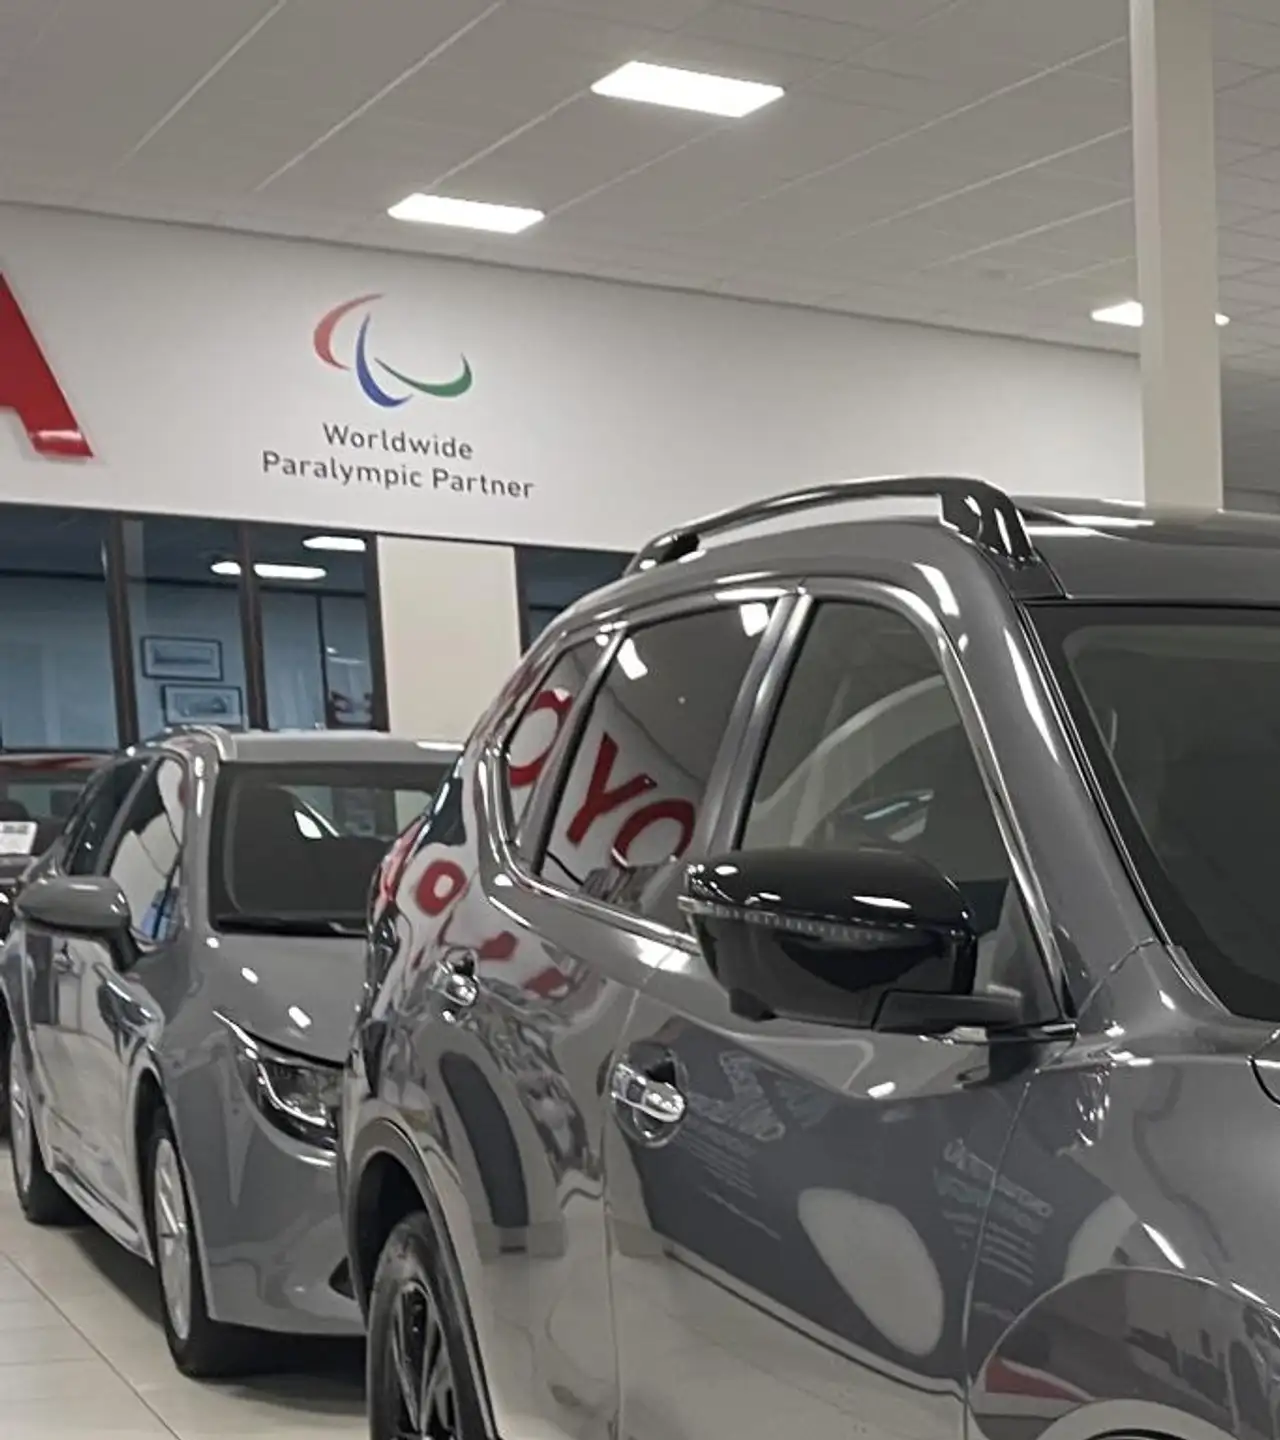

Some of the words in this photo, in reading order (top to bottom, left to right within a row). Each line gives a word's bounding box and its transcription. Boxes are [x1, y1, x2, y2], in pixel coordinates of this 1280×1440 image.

[323, 422, 473, 460] Worldwide
[262, 449, 421, 489] Paralympic
[432, 467, 535, 498] Partner
